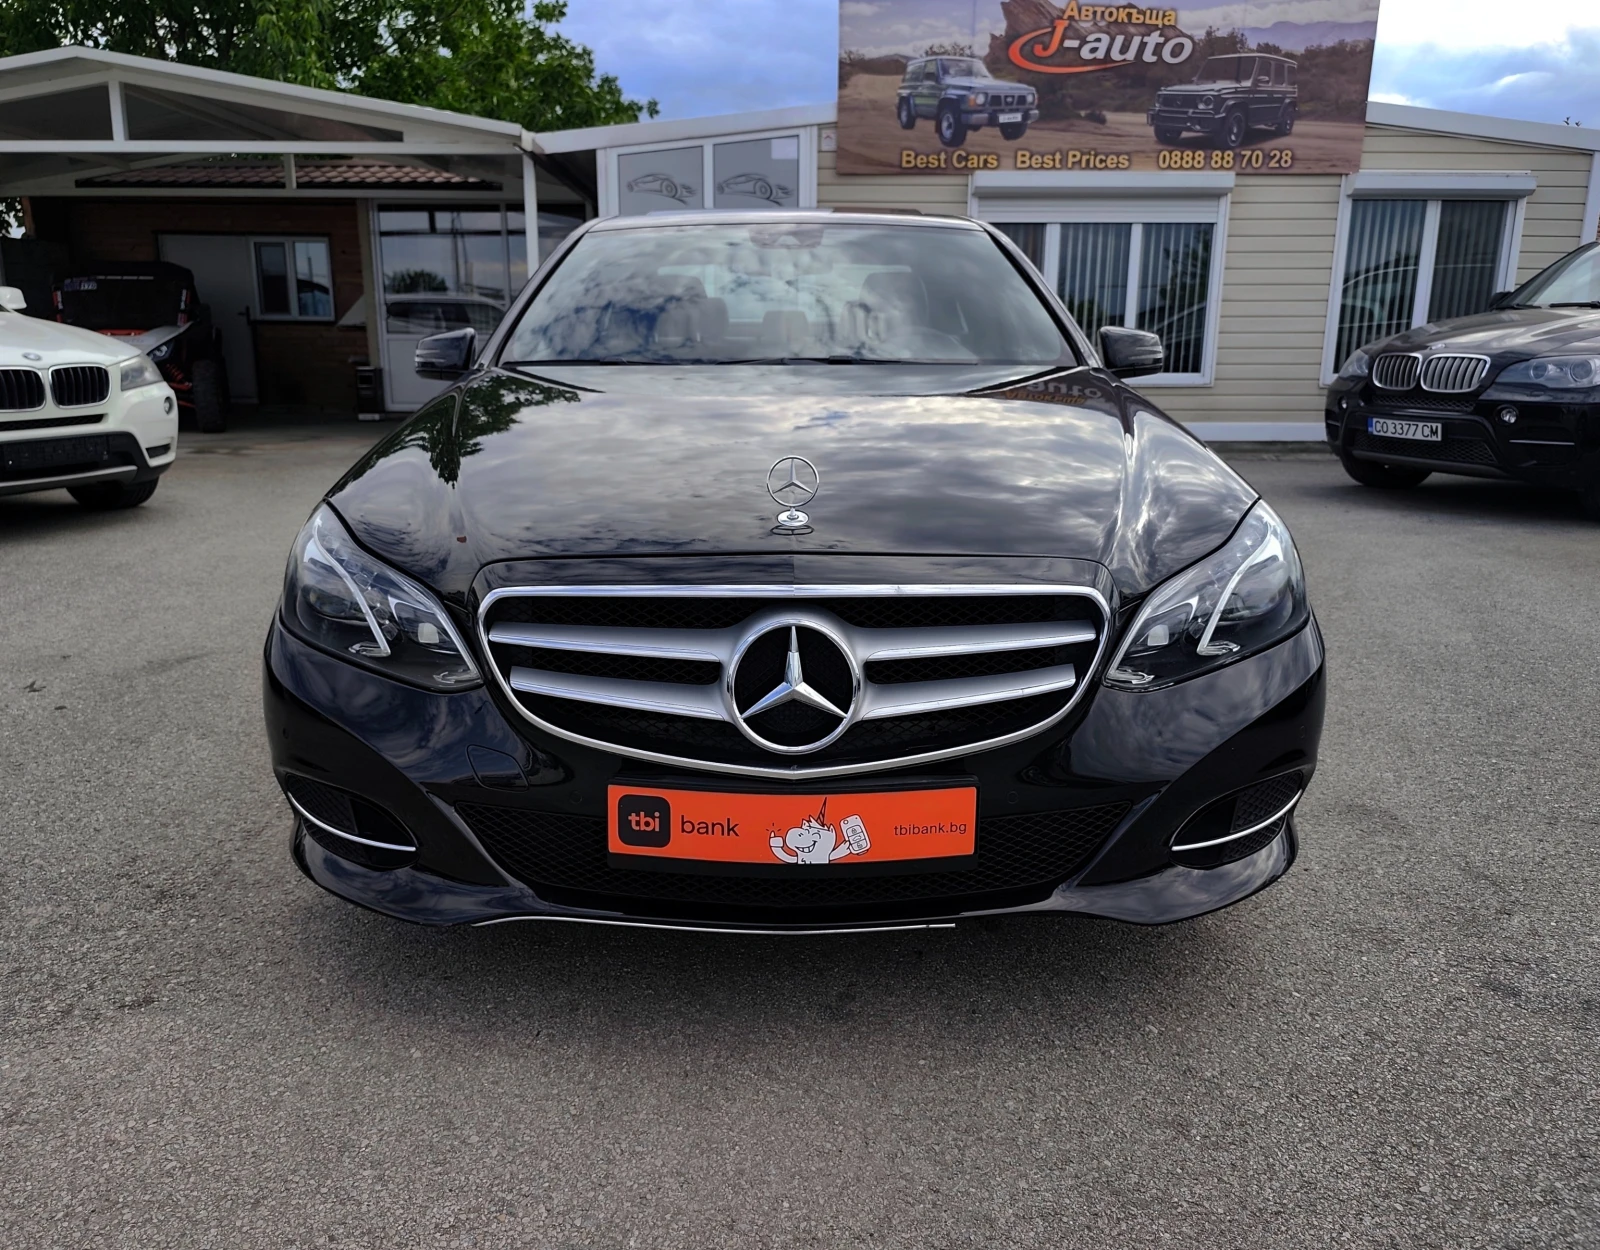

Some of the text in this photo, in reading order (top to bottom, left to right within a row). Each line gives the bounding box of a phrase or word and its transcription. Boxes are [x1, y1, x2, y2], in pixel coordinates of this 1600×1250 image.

[1063, 0, 1178, 27] Автокъща
[1033, 19, 1194, 64] J-auto
[901, 150, 999, 169] Best Cars
[1016, 150, 1130, 169] Best Prices
[1158, 150, 1293, 169] 0888 88 70 28
[1390, 422, 1418, 437] 3377
[1421, 424, 1439, 439] CM
[628, 811, 740, 837] tbi bank
[893, 822, 967, 836] tbibank.bg
